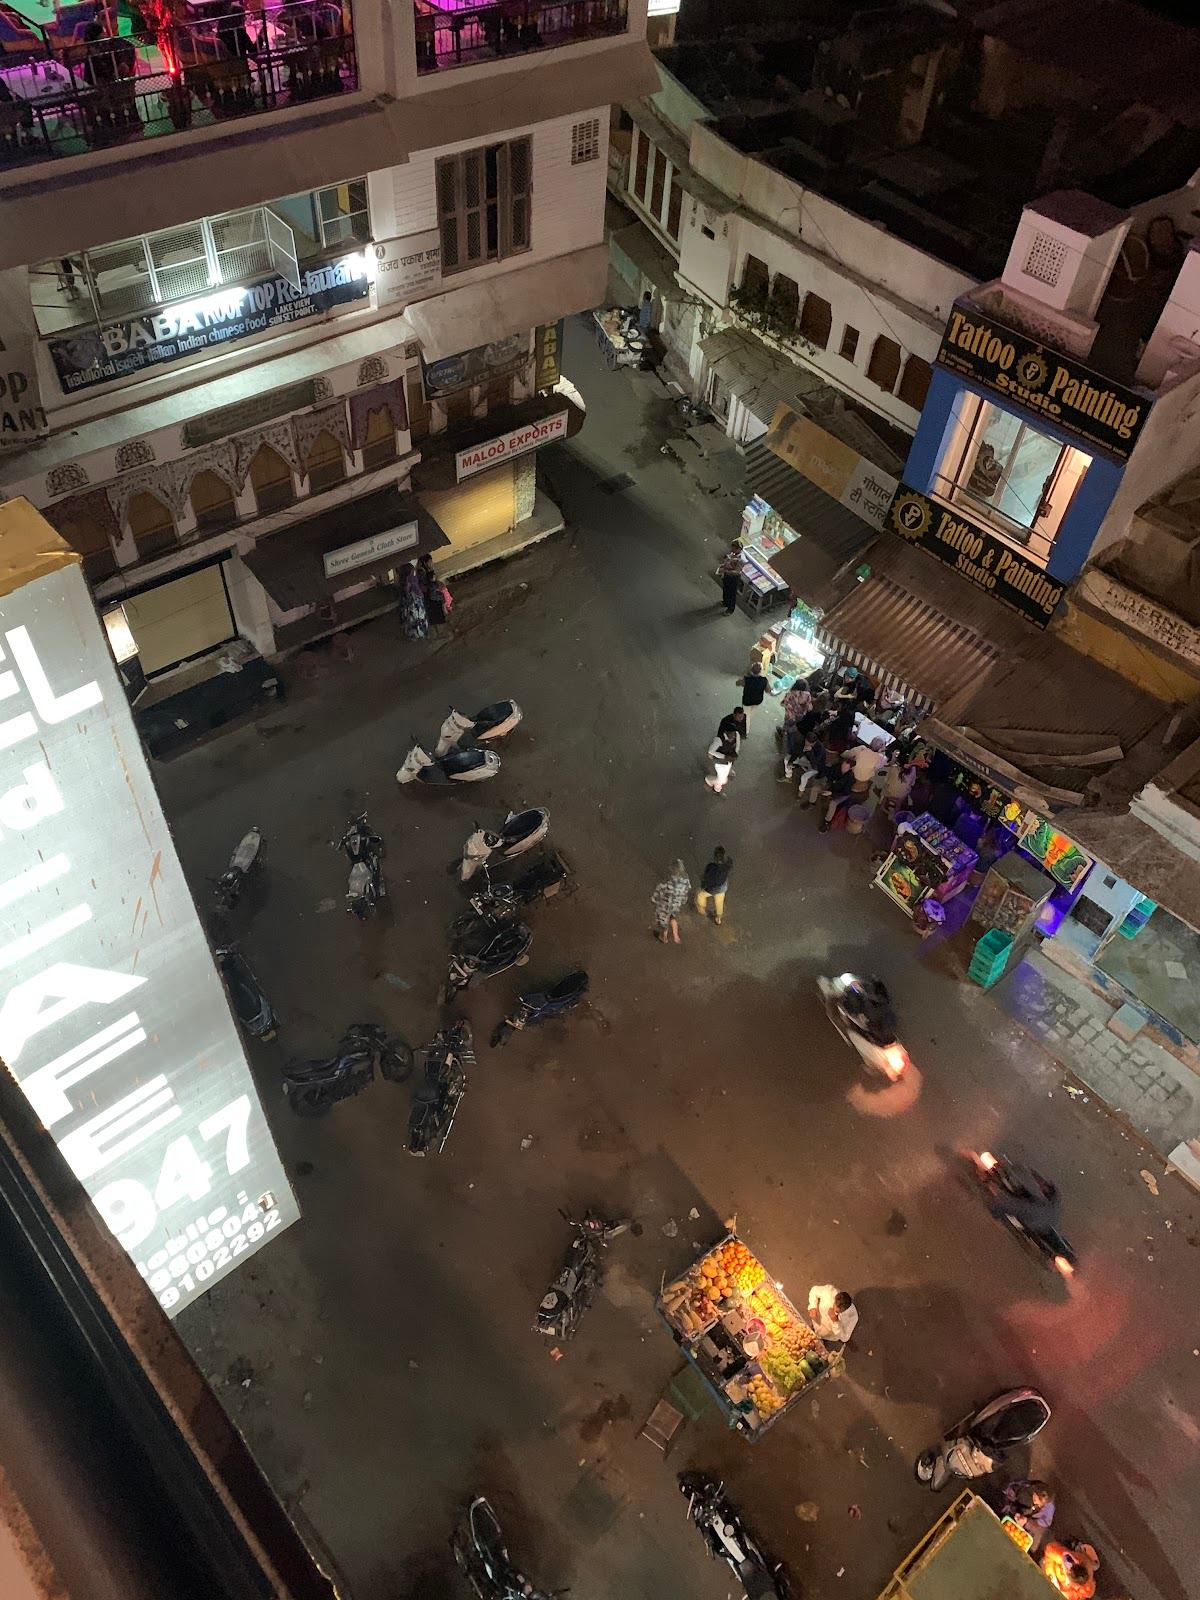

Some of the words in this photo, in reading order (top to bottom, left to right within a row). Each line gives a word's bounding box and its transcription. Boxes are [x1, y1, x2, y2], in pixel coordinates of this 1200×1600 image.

[102, 306, 205, 357] BABA
[249, 282, 275, 314] TOP
[275, 258, 362, 304] Restauran
[246, 313, 267, 331] food
[274, 303, 294, 315] LAKE
[293, 298, 311, 311] VIEW
[543, 318, 558, 371] ABA
[947, 311, 1016, 370] Tattoo
[1047, 366, 1141, 439] Painting
[995, 372, 1062, 414] Studio
[0, 406, 49, 433] ANT
[461, 441, 505, 468] MALOO
[509, 420, 562, 449] EXPORTS
[849, 487, 862, 504] टी
[863, 476, 893, 503] गोपाल
[935, 512, 984, 560] Tattoo
[981, 548, 995, 569] &
[994, 549, 1063, 615] Painting
[955, 553, 997, 589] Studio
[159, 1209, 282, 1309] 9102292
